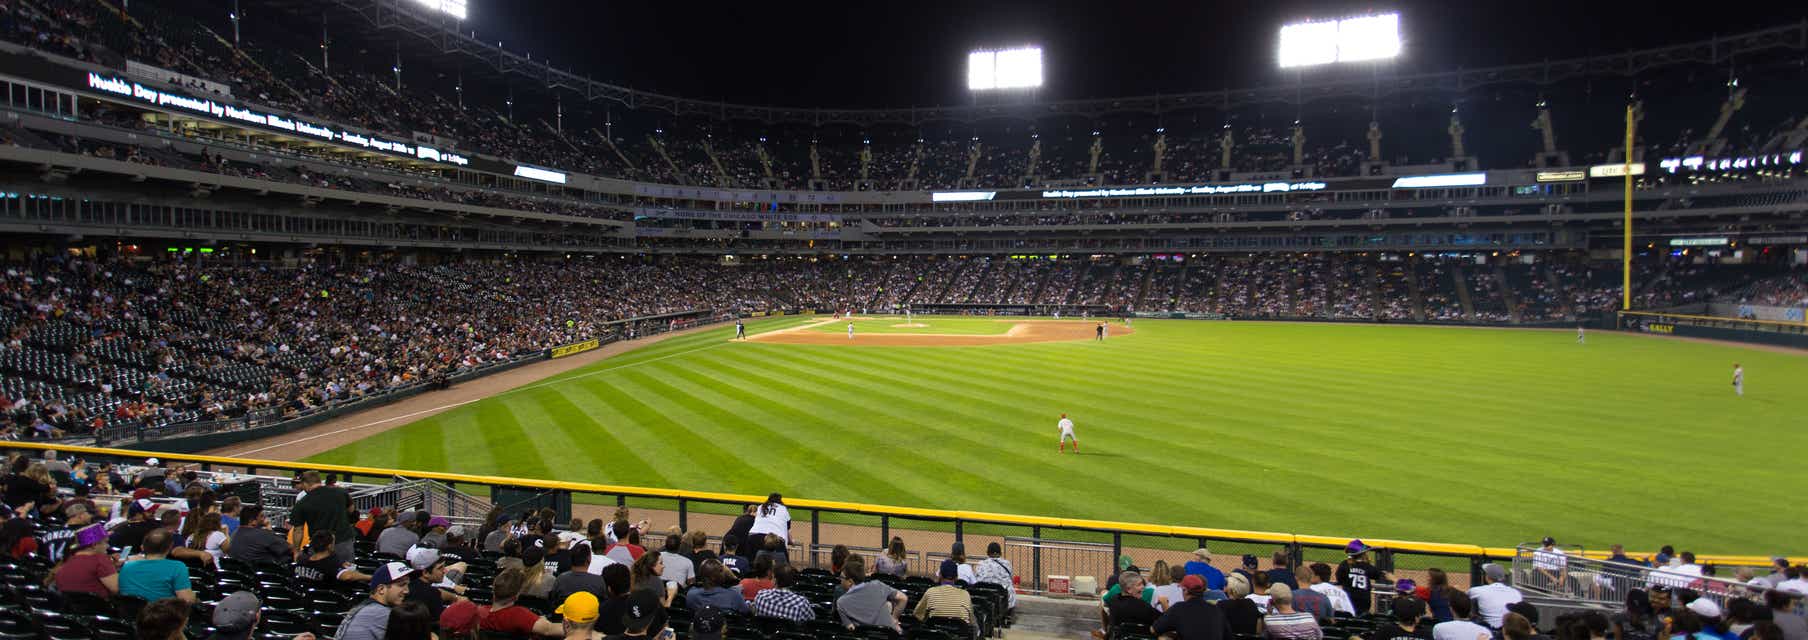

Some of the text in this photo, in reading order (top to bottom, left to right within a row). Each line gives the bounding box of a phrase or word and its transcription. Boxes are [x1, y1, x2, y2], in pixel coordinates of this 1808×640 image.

[88, 72, 132, 96] Huskie
[134, 83, 158, 103] Day
[158, 92, 210, 113] presented
[211, 101, 224, 117] by
[225, 105, 267, 124] Northern
[267, 115, 296, 131] Illinois
[296, 121, 334, 140] University
[370, 137, 392, 150] August
[1347, 573, 1367, 590] 79
